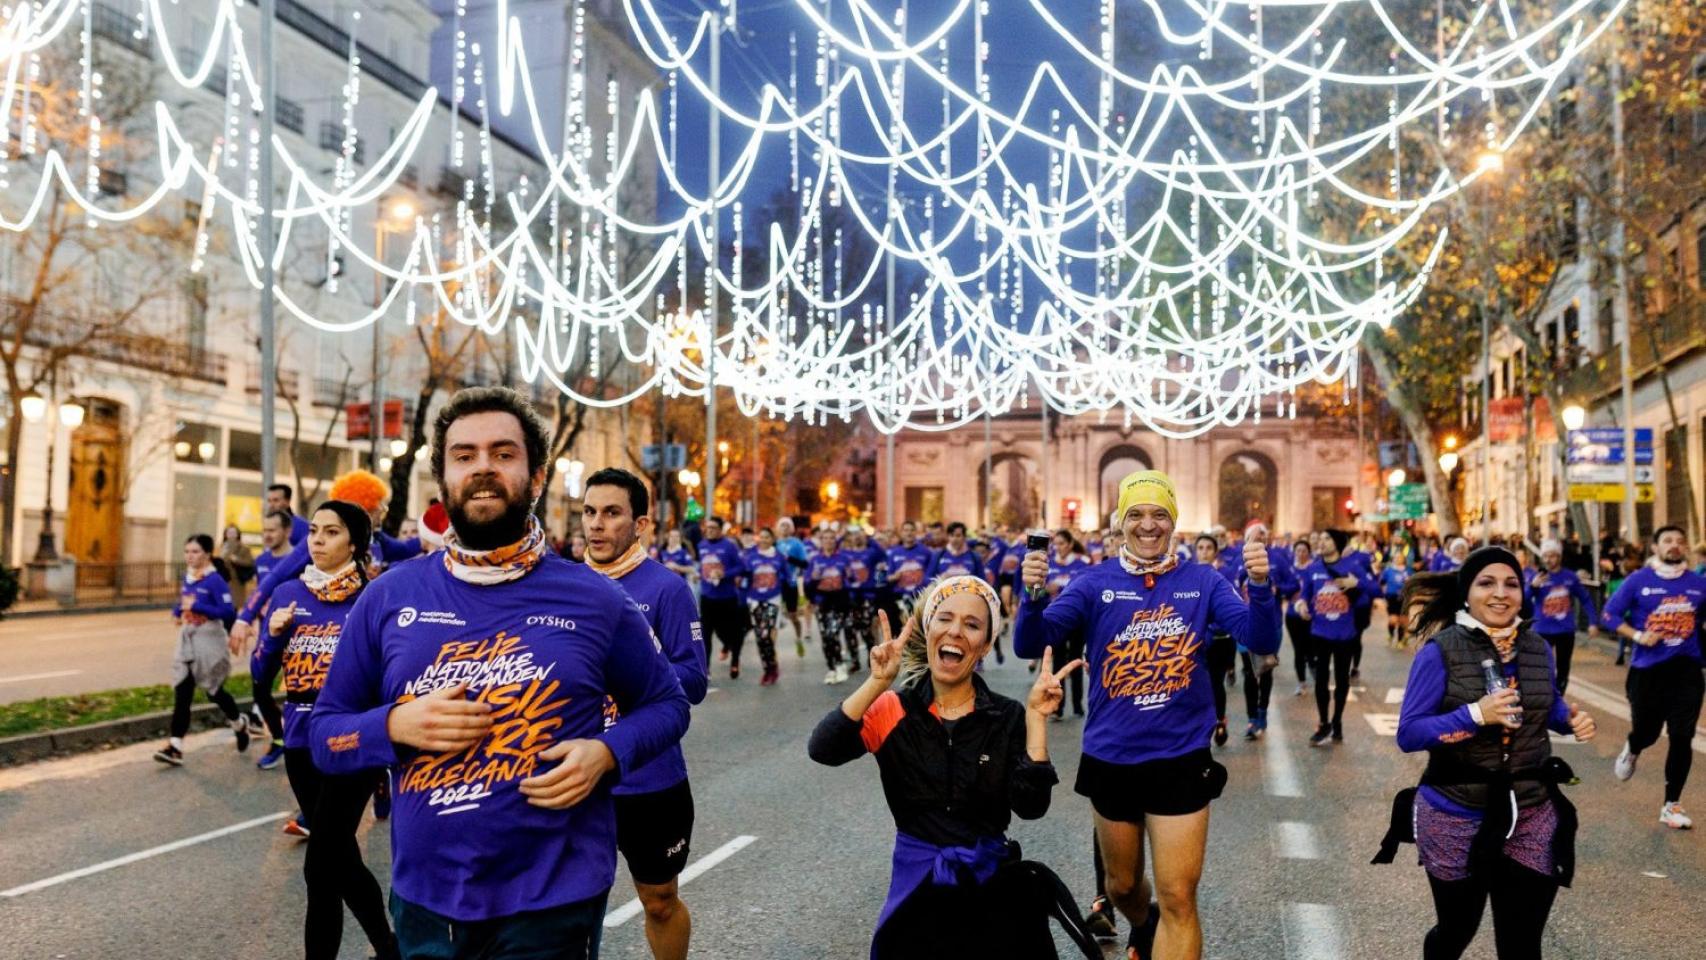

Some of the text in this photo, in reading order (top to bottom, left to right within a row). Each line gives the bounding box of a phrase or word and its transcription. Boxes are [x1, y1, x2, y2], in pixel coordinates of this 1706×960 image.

[1173, 590, 1201, 599] OYSHO
[417, 617, 466, 626] nederlanden
[526, 615, 576, 630] OYSHO
[1132, 603, 1181, 627] FELIZ
[288, 635, 340, 647] NATIONAL
[435, 631, 530, 666] FELIZ
[1105, 631, 1203, 663] SANSIL
[423, 652, 534, 680] NATIONALE
[404, 661, 556, 695] NEDERLANDEN
[1133, 693, 1171, 705] 2022
[399, 753, 538, 794] VALLECANA
[428, 783, 492, 806] 2022
